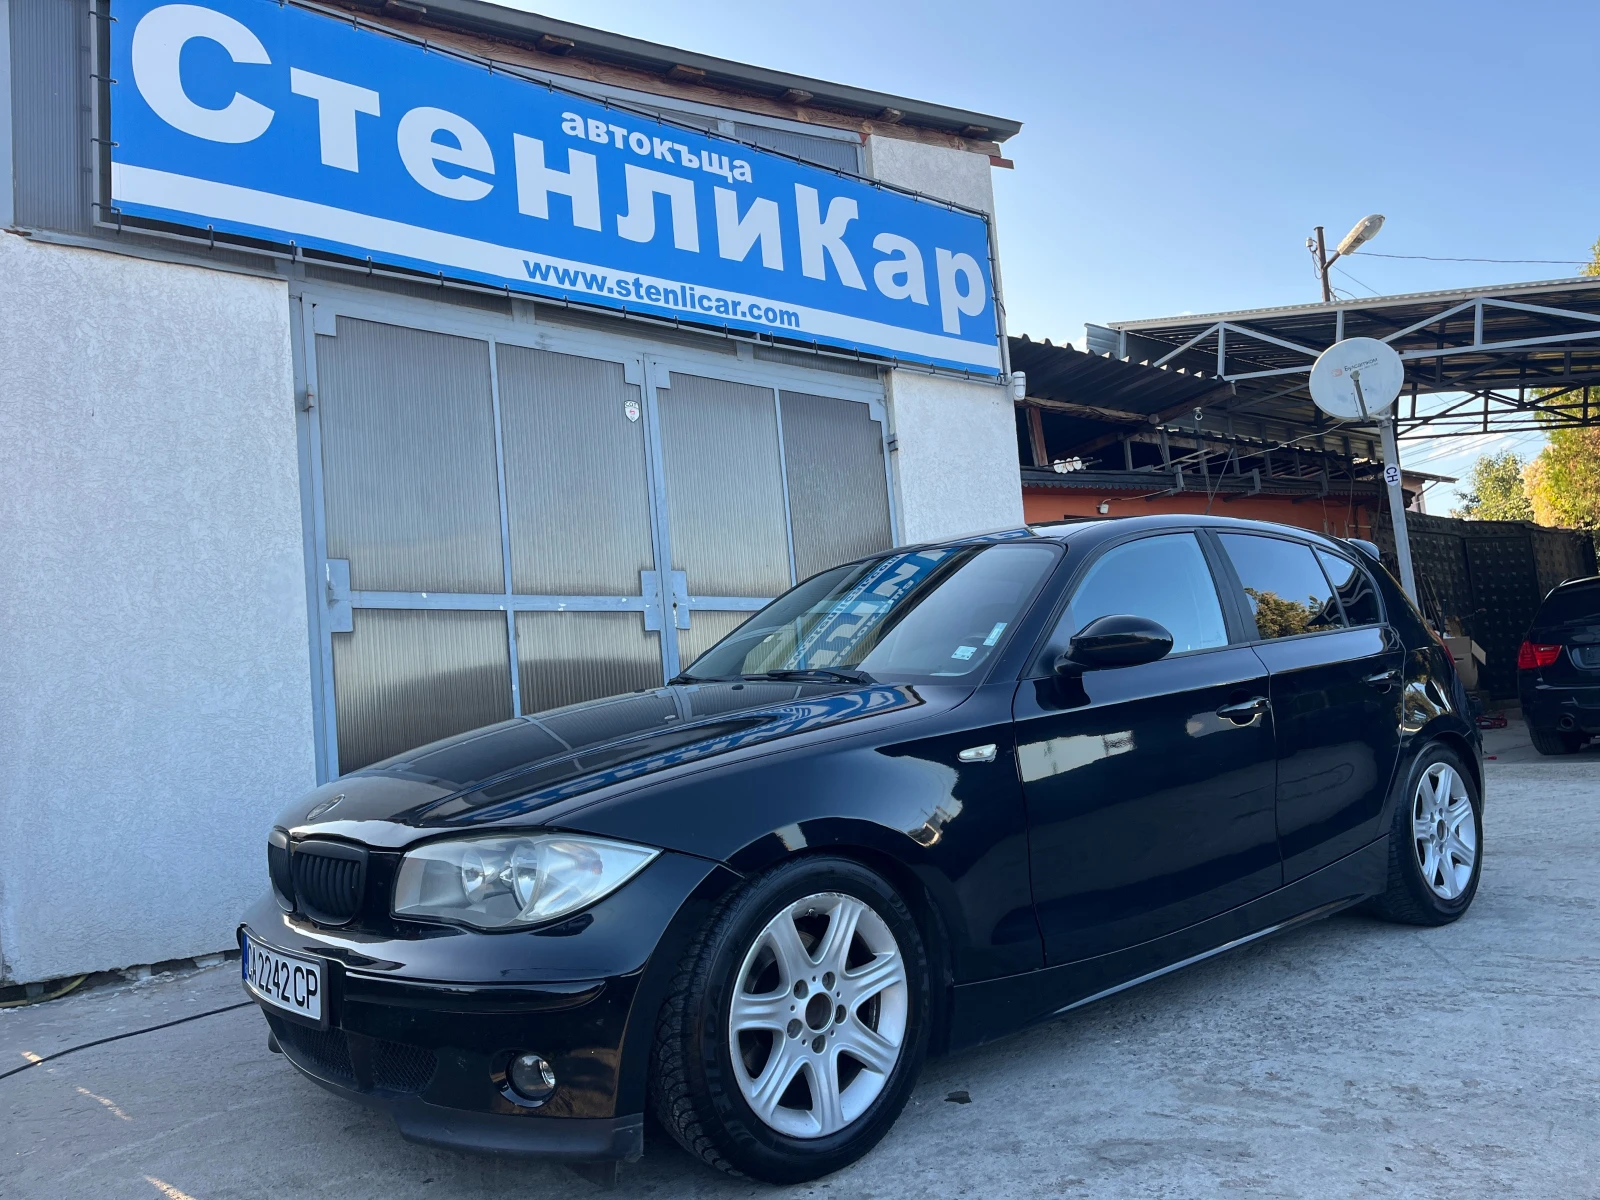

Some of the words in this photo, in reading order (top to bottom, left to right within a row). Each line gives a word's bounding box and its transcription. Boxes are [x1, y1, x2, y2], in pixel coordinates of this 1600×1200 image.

[131, 4, 986, 335] СтенлиКар
[561, 111, 753, 184] автокъща
[523, 259, 800, 328] www.stenlicar.com
